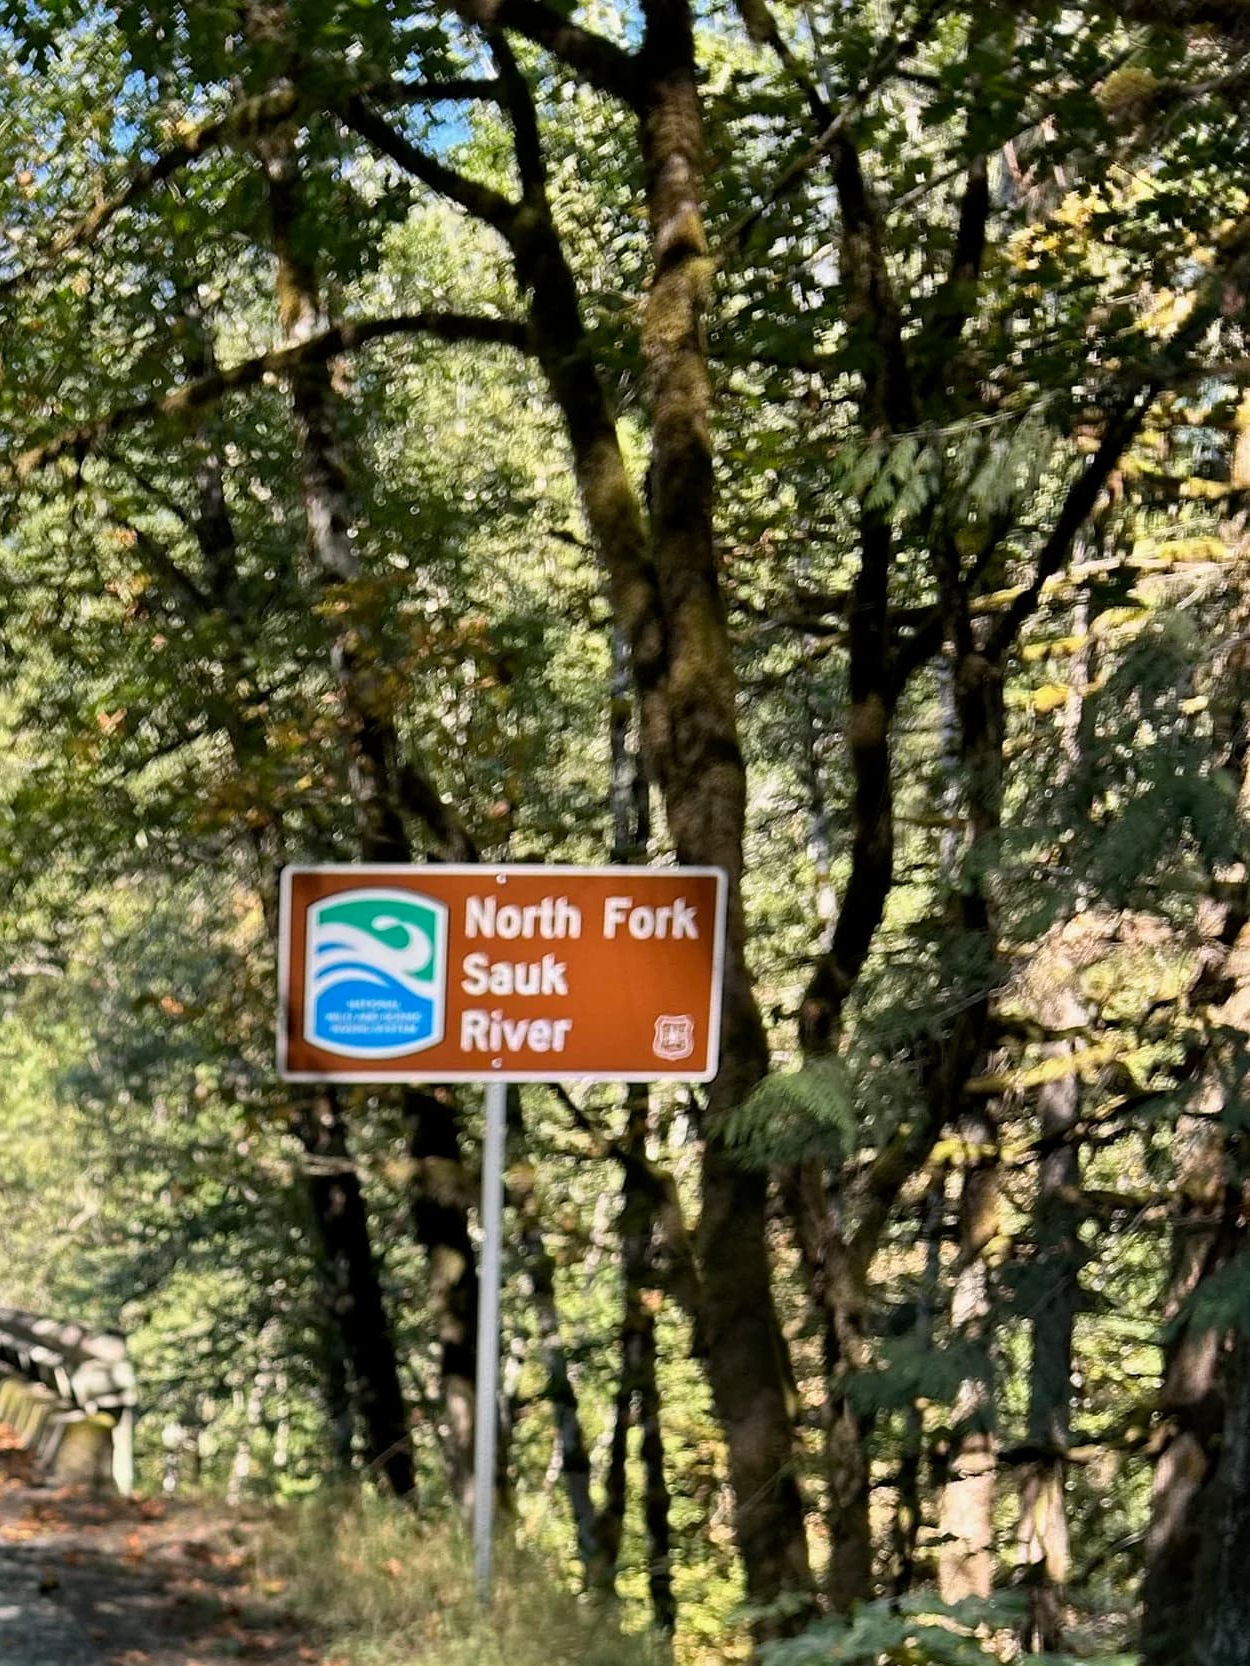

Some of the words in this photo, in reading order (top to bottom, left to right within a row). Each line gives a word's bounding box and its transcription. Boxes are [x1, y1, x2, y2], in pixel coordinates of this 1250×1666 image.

[464, 895, 582, 940] North
[603, 896, 700, 941] Fork
[461, 952, 569, 997] Sauk
[460, 1008, 573, 1053] River
